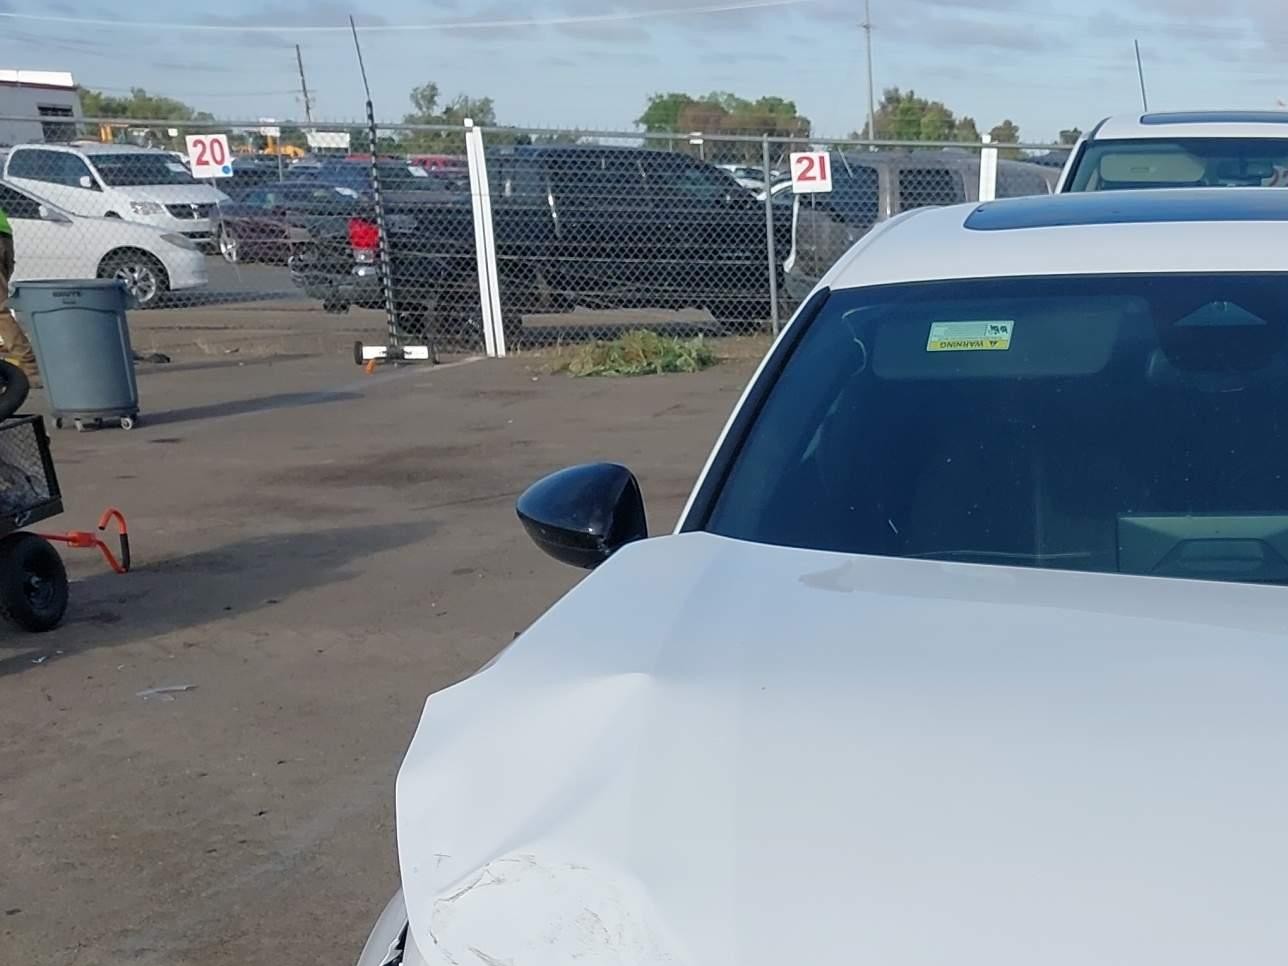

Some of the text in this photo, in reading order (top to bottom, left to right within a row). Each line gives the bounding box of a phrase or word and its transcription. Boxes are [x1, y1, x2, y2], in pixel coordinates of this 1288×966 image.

[192, 137, 226, 166] 20
[795, 155, 827, 181] 21
[938, 341, 985, 349] WARNING
